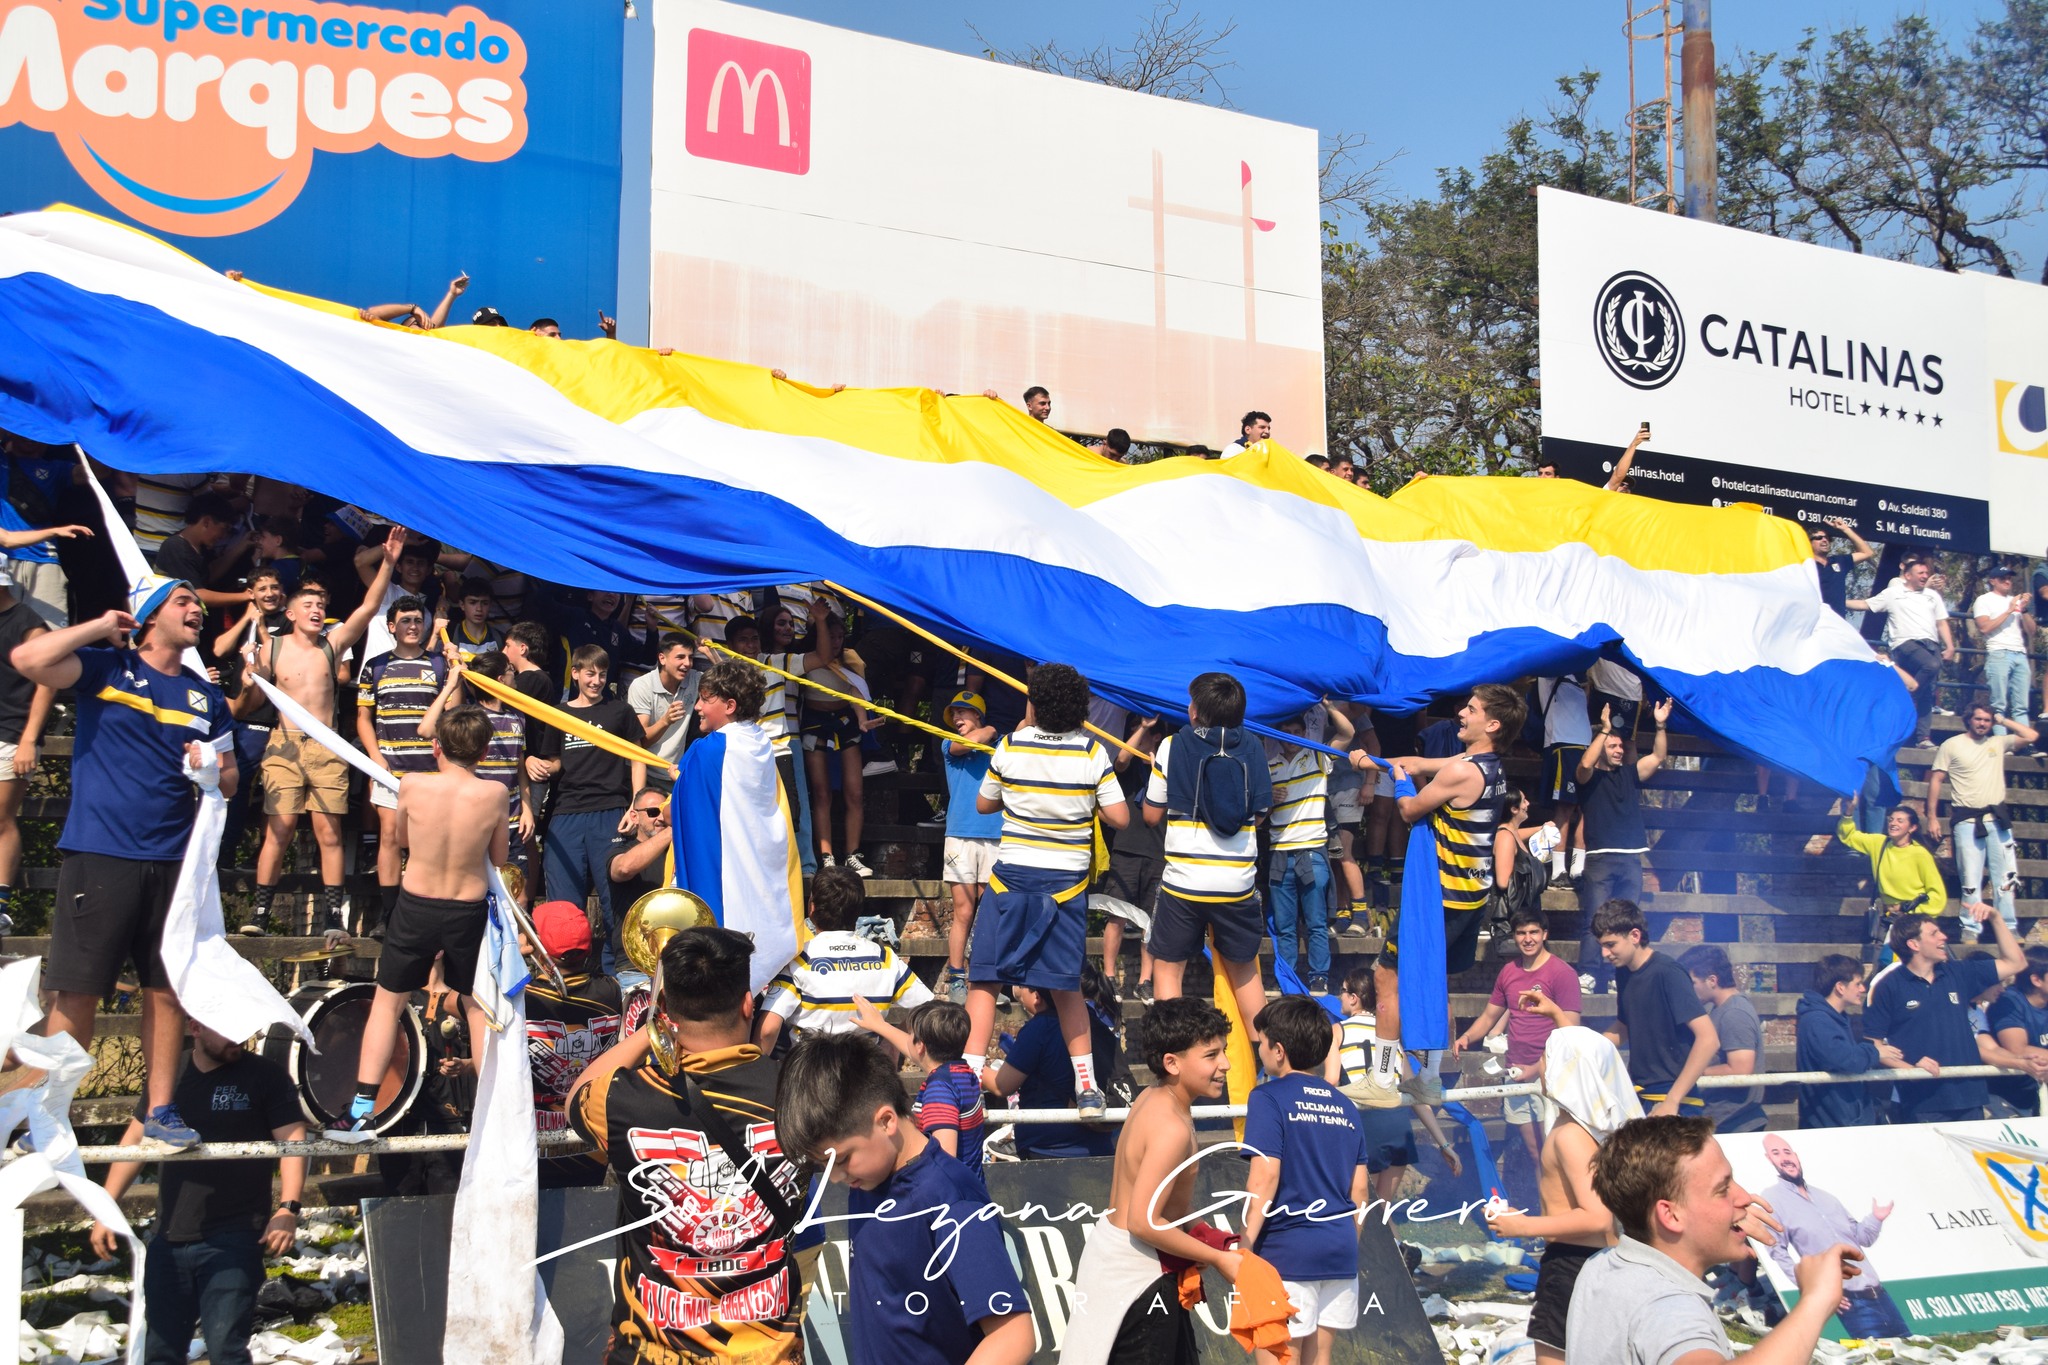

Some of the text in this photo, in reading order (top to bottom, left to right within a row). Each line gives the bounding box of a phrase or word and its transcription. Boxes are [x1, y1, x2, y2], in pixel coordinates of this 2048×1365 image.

[1700, 313, 1944, 396] CATALINAS
[1790, 386, 1857, 417] HOTEL
[1613, 466, 1685, 484] alinas.hotel
[1722, 478, 1858, 507] hotelcatalinastucuman.com.ar
[1807, 512, 1821, 524] 381
[1887, 502, 1947, 519] Av. Soldati 380
[1887, 522, 1897, 533] M.
[1899, 523, 1910, 535] de
[1912, 525, 1951, 541] Tucumán
[837, 959, 882, 972] Macro
[212, 1093, 250, 1103] FORZA
[1295, 1101, 1343, 1115] TUCUMAN
[1288, 1112, 1317, 1123] LAWN
[696, 1257, 748, 1274] LBDC
[1905, 1298, 1932, 1321] AV.
[1926, 1294, 1968, 1319] SOLA
[1959, 1291, 2003, 1315] VERA
[1994, 1288, 2031, 1313] ESQ.
